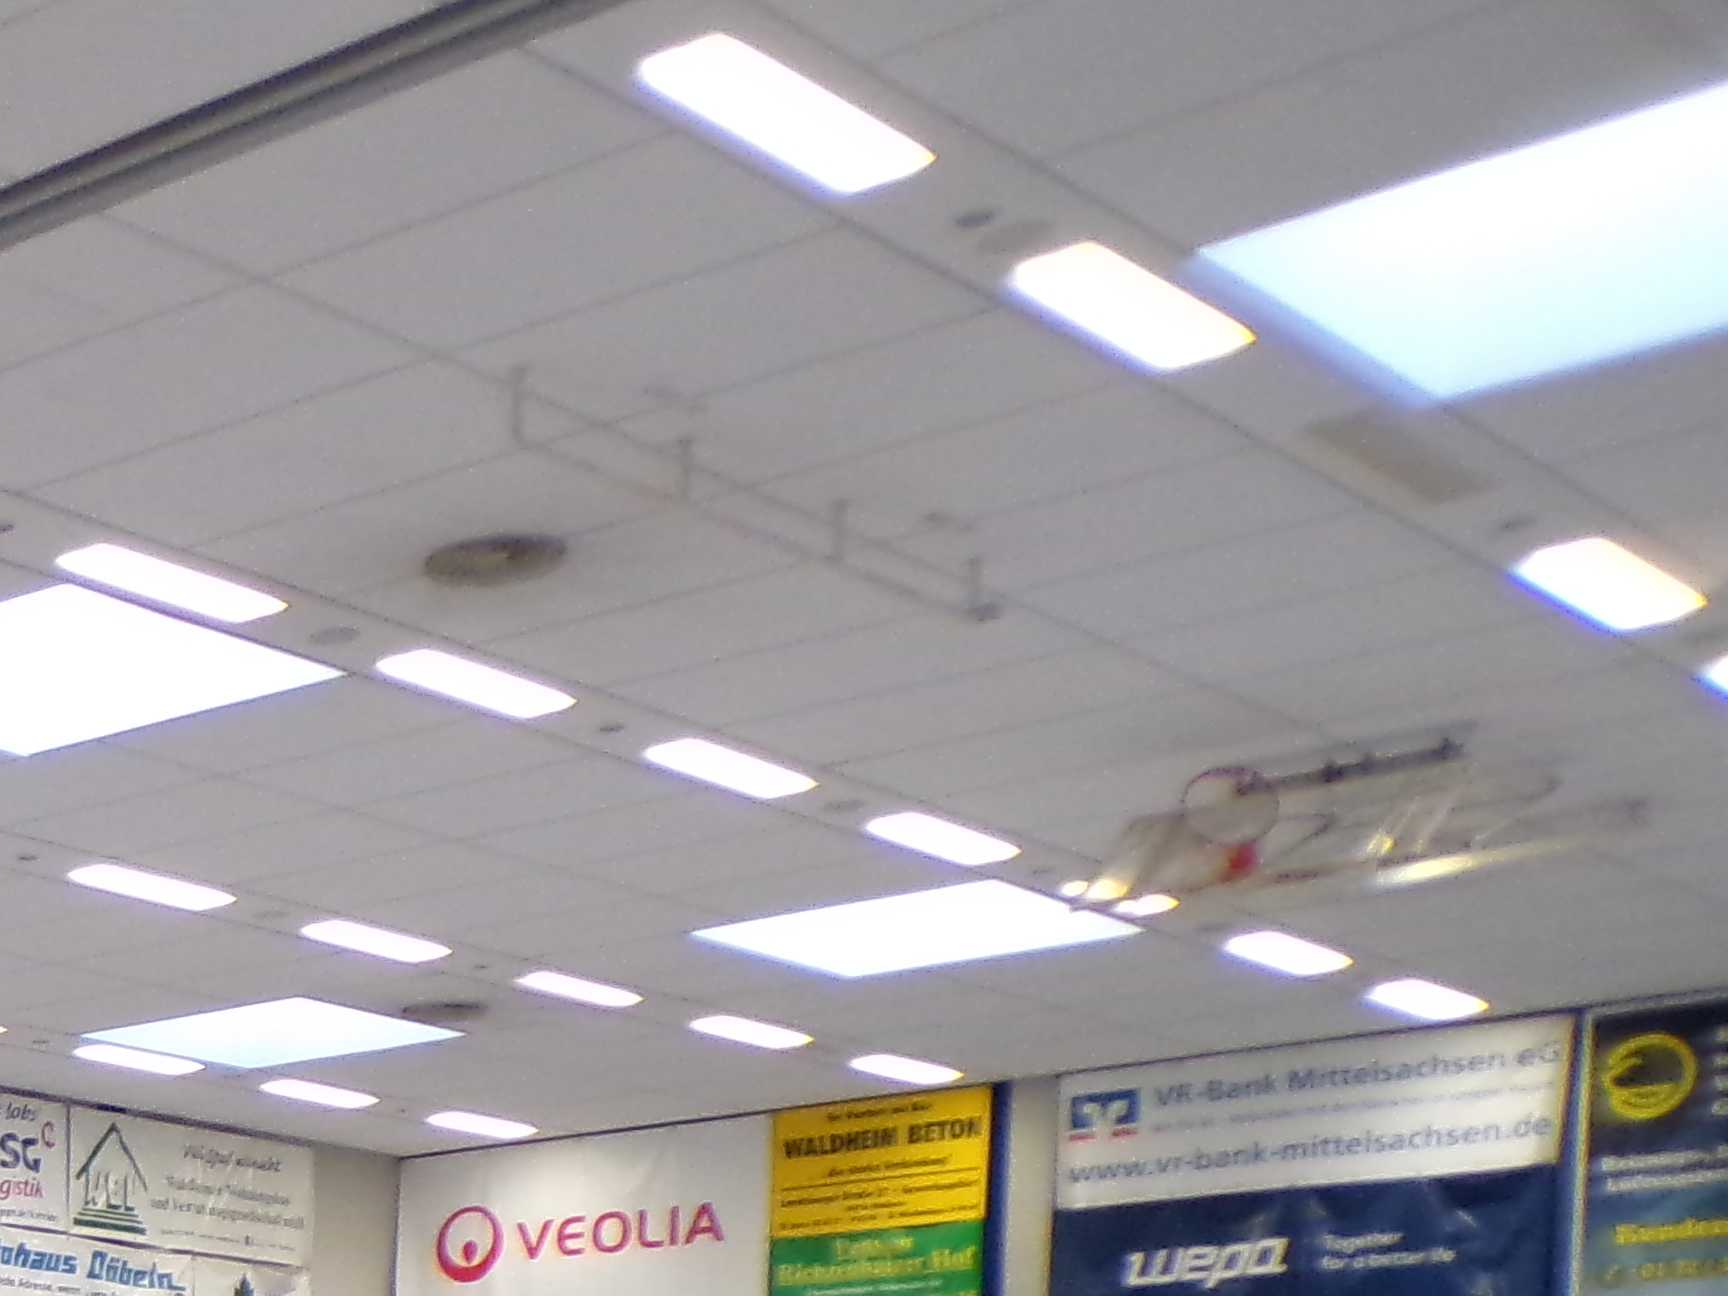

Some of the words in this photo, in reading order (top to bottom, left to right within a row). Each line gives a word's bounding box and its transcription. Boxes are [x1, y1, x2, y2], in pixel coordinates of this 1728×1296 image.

[1152, 1074, 1279, 1107] VR-Bank
[1288, 1052, 1507, 1093] Mittelsachsen
[783, 1125, 898, 1159] WALDHEIM
[907, 1115, 983, 1145] BETON
[1068, 1114, 1553, 1184] www.vr-bank-mittelsachsen.de
[516, 1201, 725, 1261] VEOLIA
[86, 1249, 184, 1292] Döbeln
[1124, 1236, 1290, 1290] wepa
